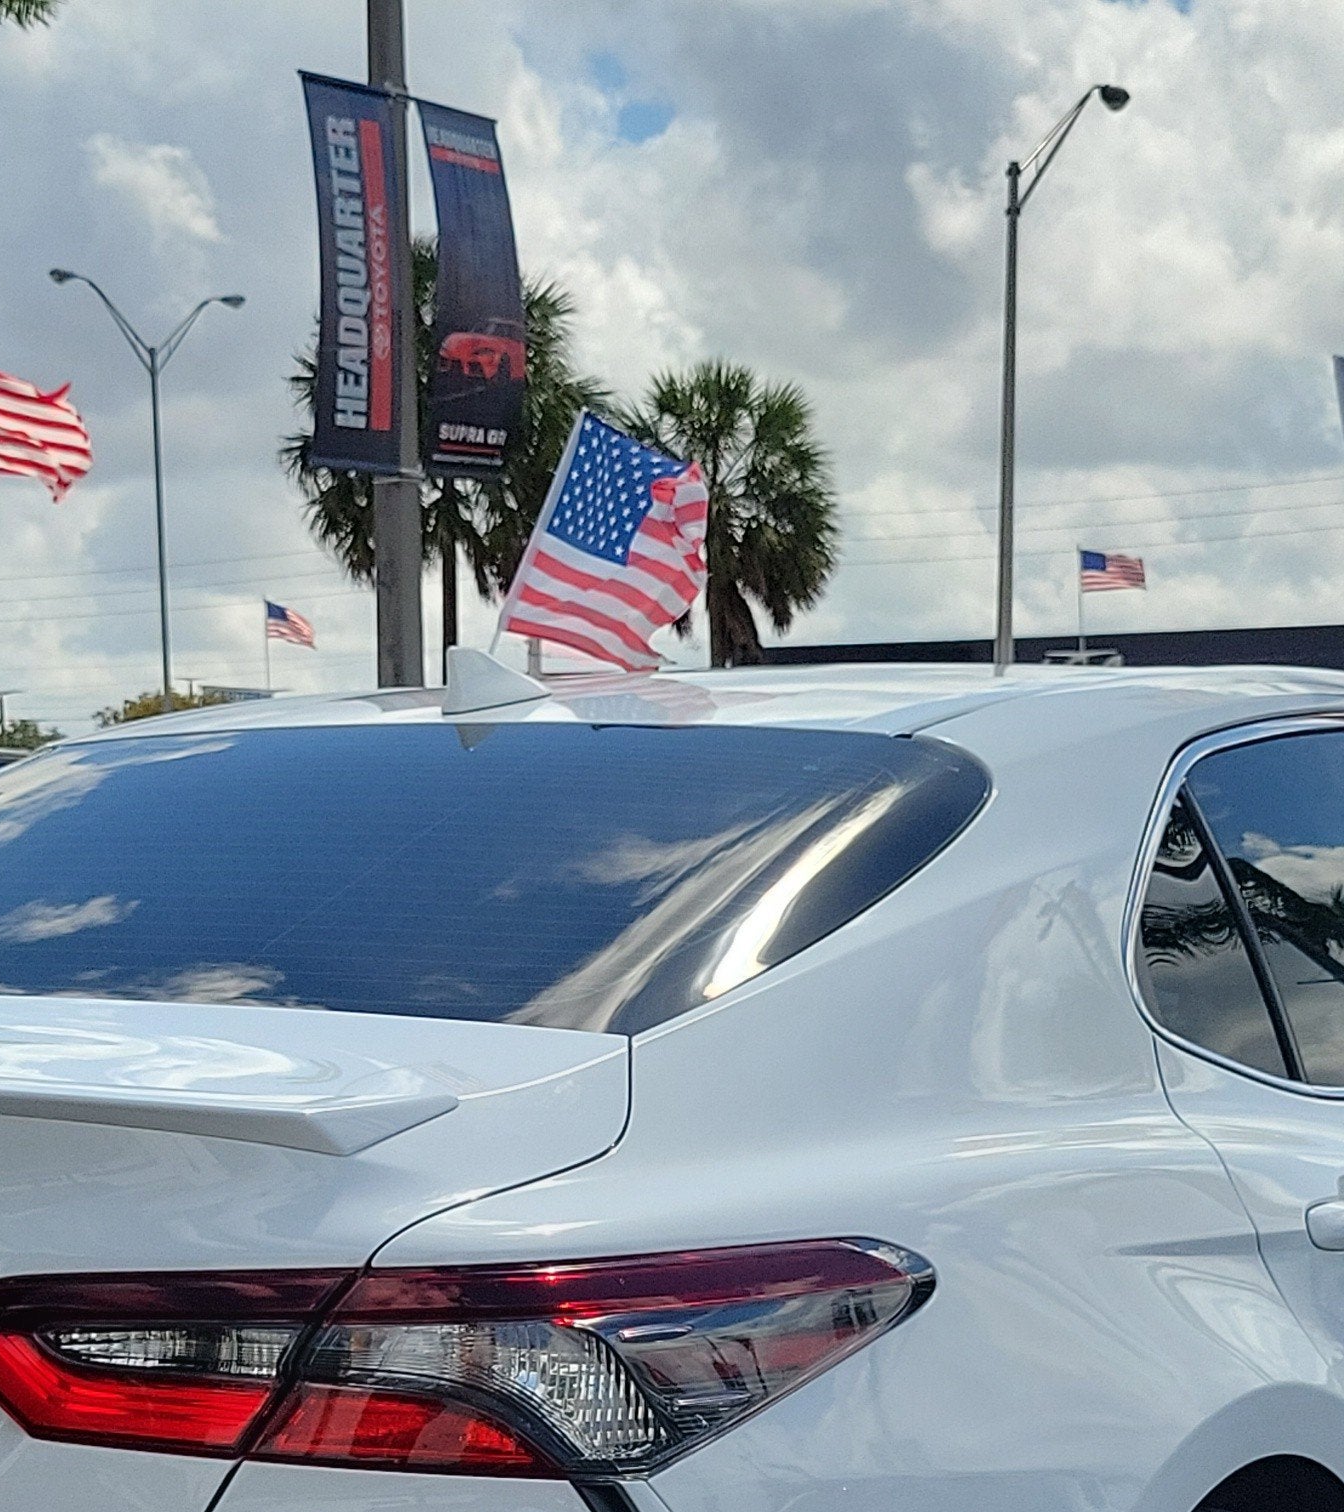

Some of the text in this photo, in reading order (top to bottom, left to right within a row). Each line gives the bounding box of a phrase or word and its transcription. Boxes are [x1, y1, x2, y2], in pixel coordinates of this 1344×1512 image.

[326, 115, 370, 430] HEADQUARTER
[369, 203, 388, 321] TOYOTA
[438, 421, 485, 444] SUPRA
